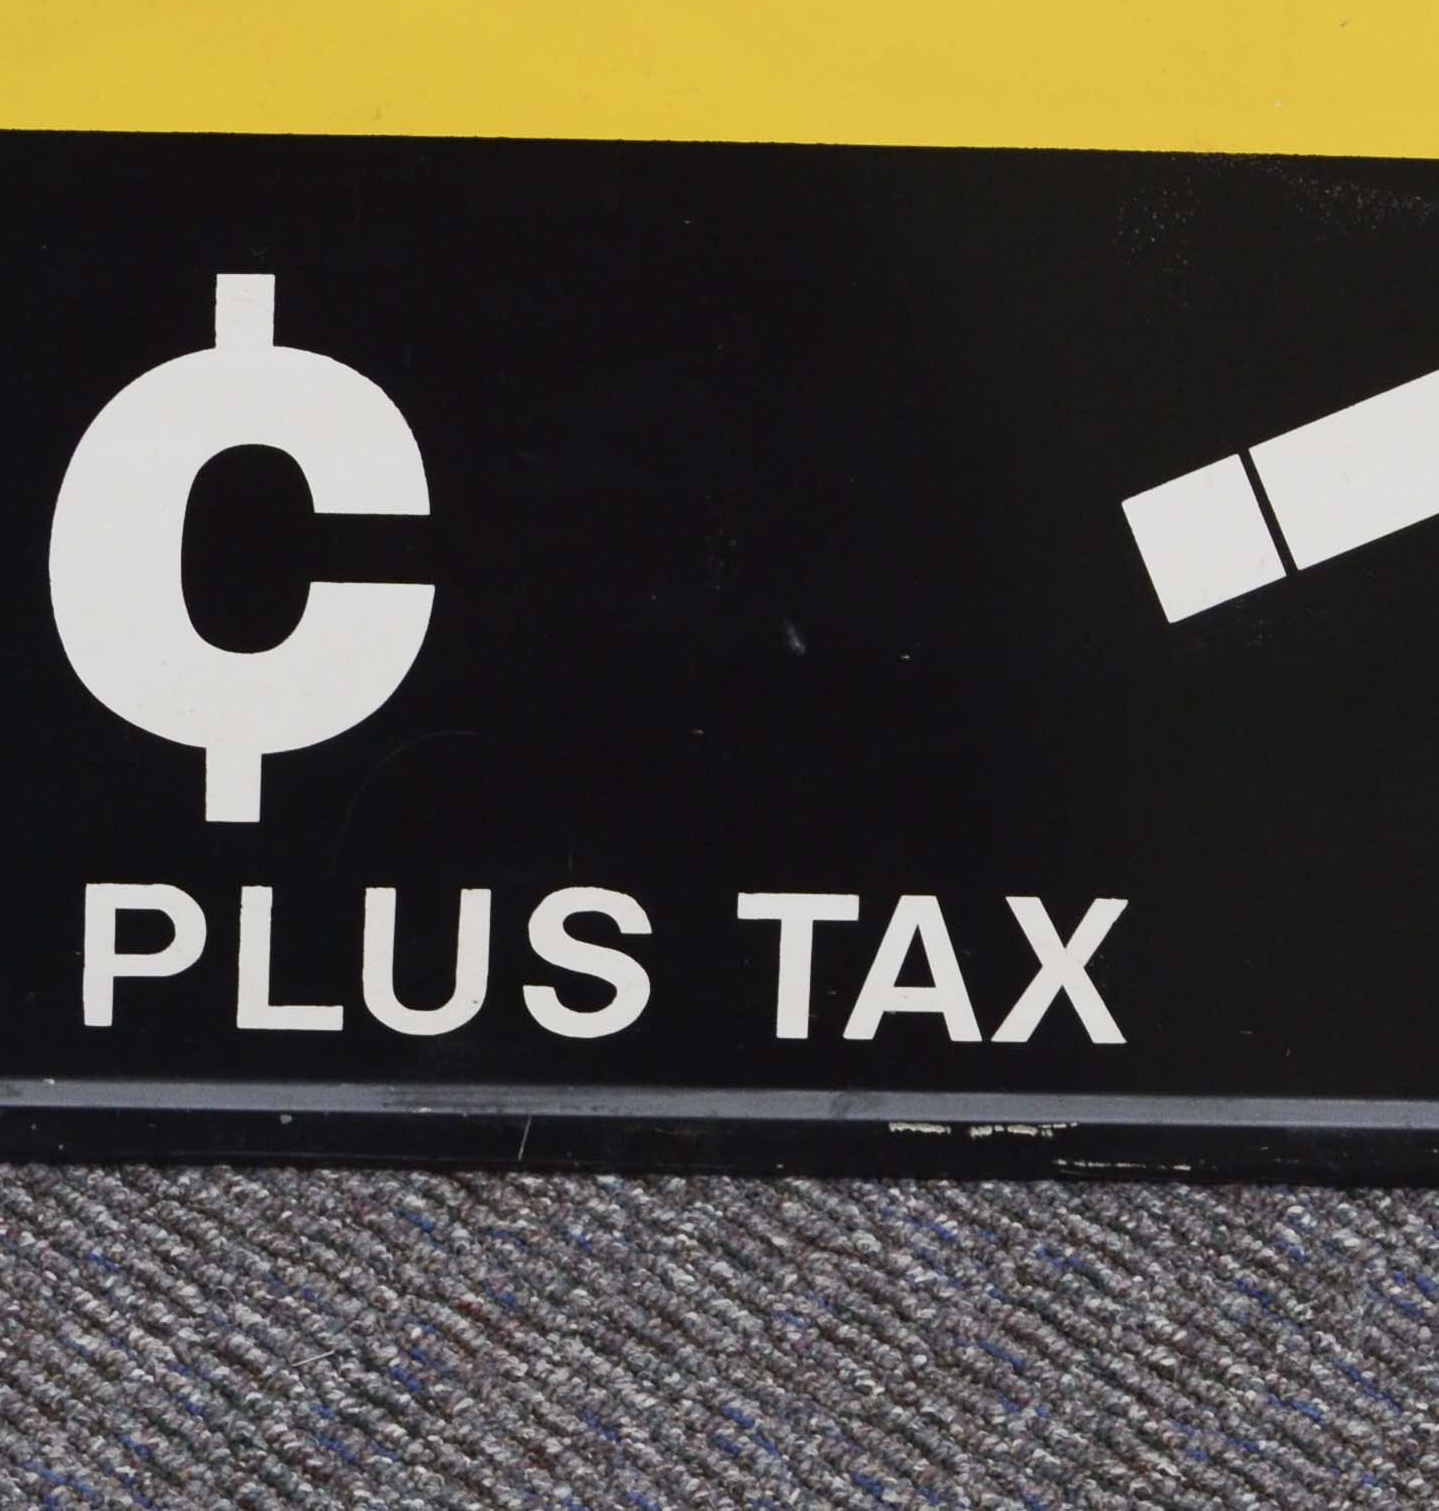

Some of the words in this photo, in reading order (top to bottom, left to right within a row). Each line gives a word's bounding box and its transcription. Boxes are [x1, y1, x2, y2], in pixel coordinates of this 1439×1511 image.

[49, 274, 435, 822] ¢
[83, 883, 652, 1038] PLUS
[738, 893, 1128, 1043] TAX
